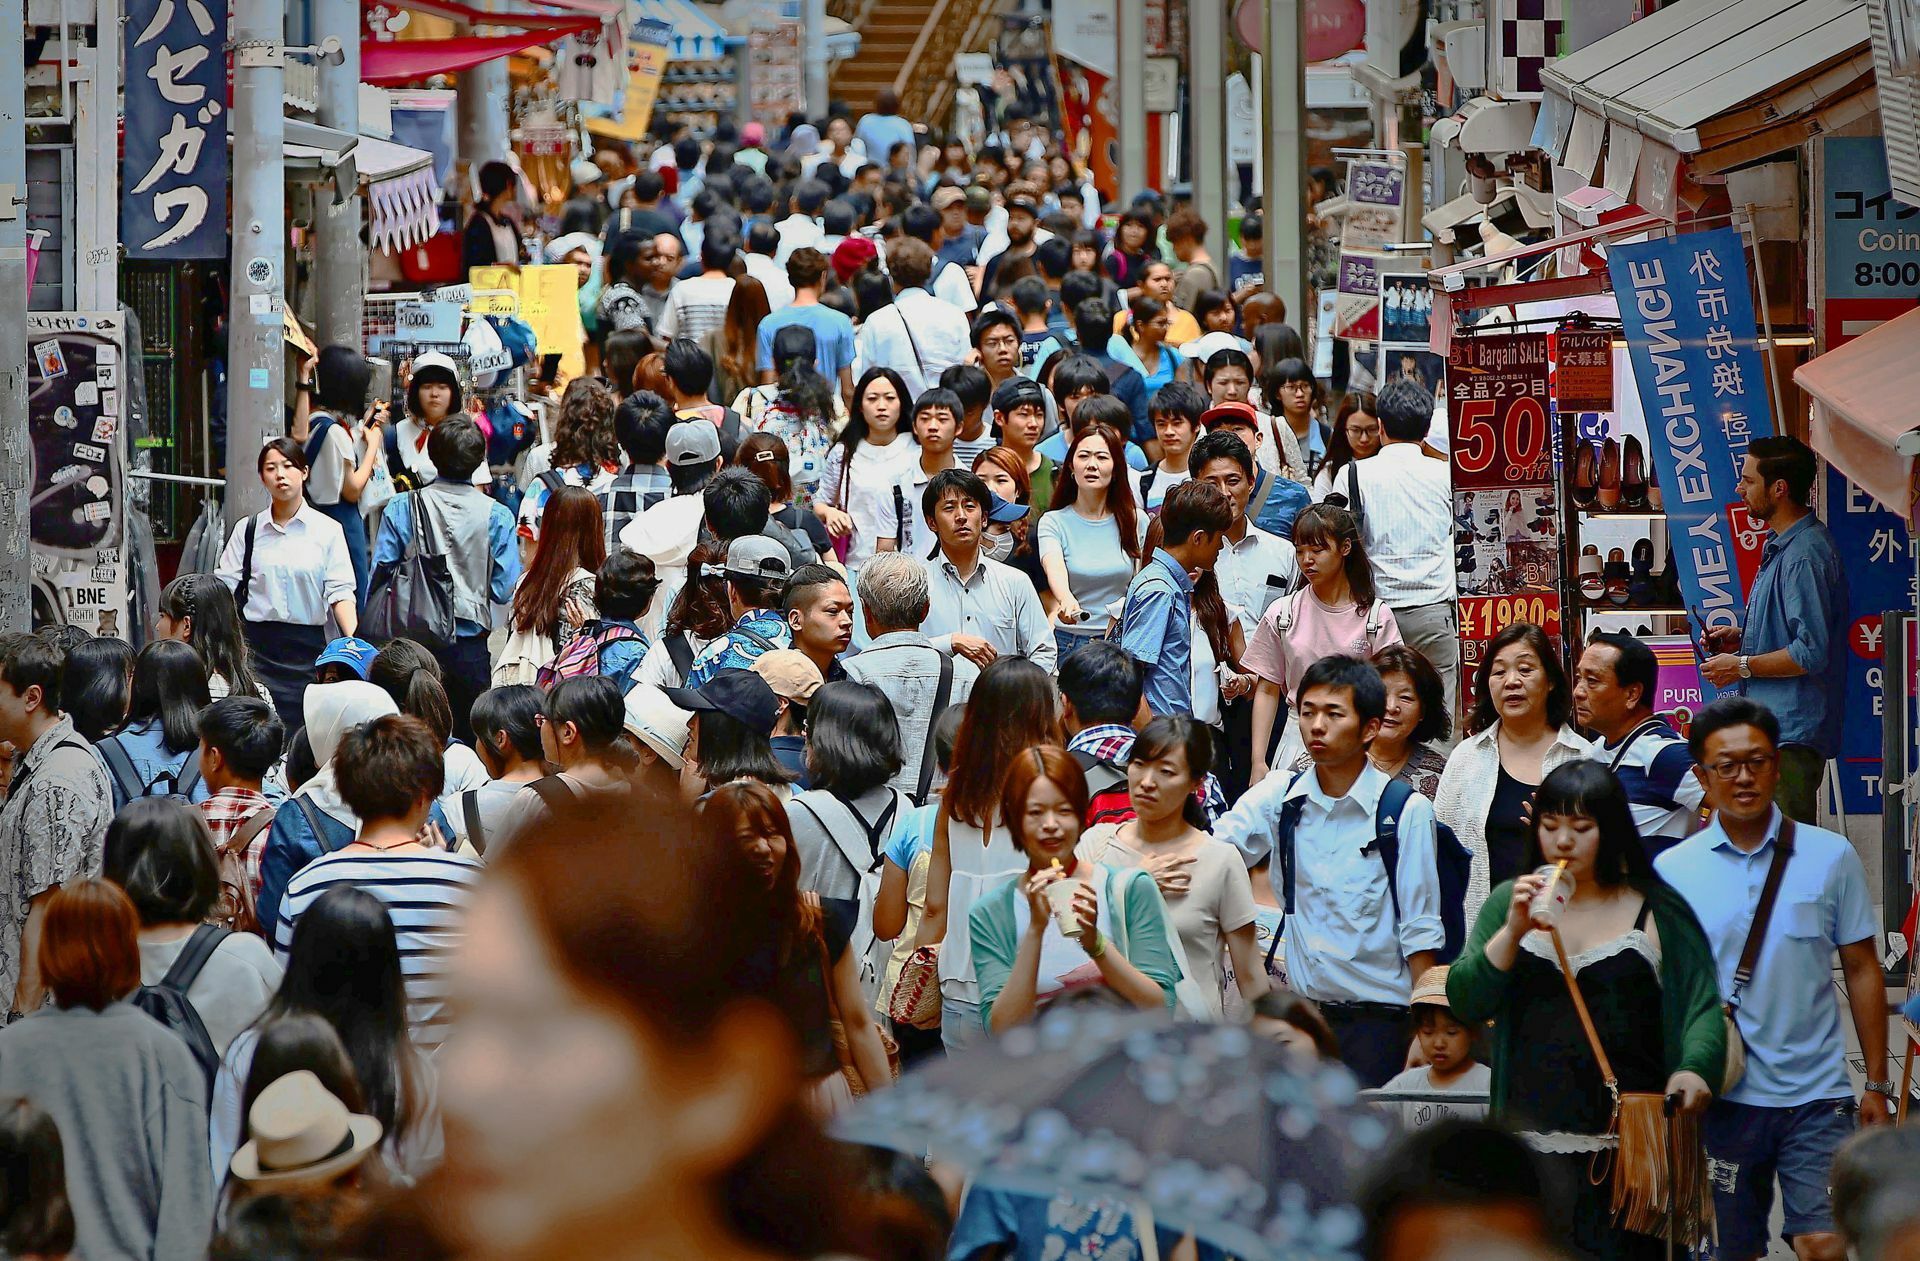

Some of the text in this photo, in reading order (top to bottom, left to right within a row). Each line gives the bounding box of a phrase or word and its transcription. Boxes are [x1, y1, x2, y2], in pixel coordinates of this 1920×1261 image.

[1858, 228, 1920, 252] Coin
[1560, 336, 1609, 348] アルバイト
[1479, 342, 1518, 371] Bargain
[1519, 341, 1545, 363] SALE
[1562, 351, 1607, 366] 大募集
[1504, 463, 1550, 481] Off
[1526, 562, 1551, 583] B1
[76, 588, 106, 605] BNE
[67, 609, 94, 622] EIGHTH
